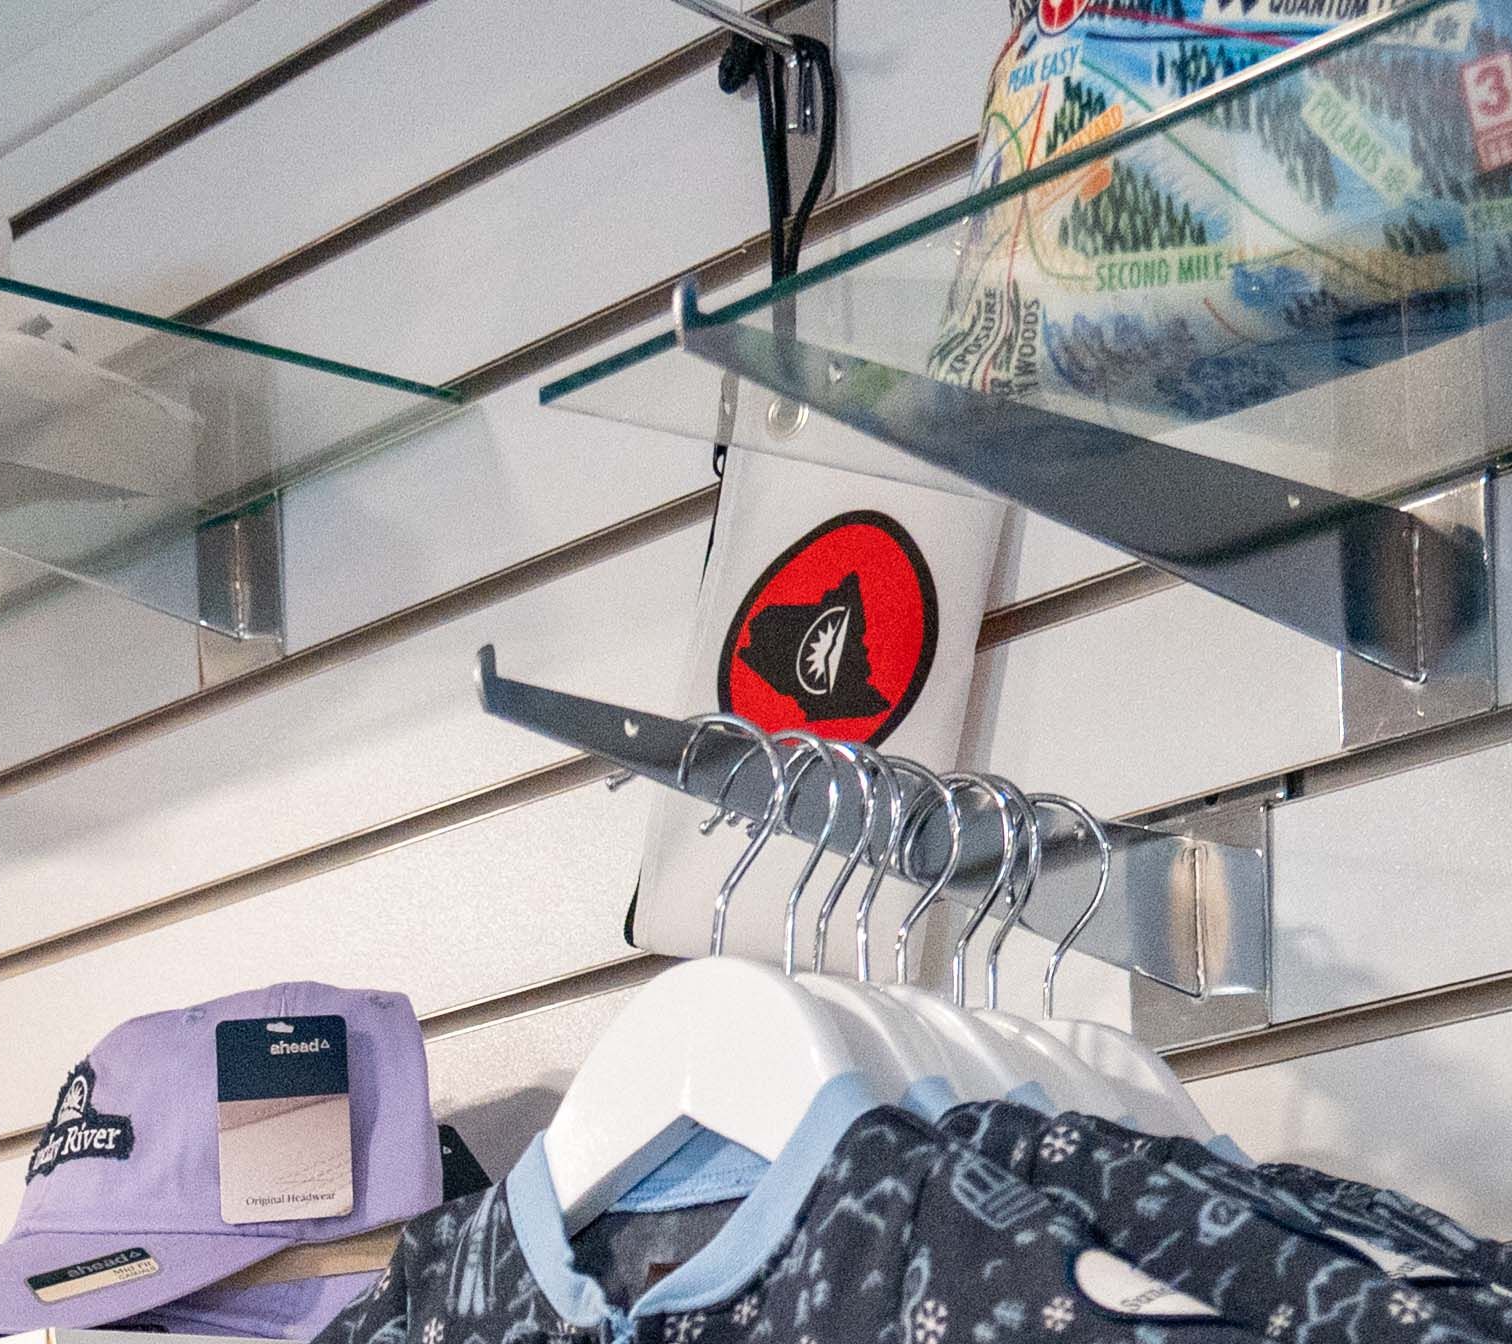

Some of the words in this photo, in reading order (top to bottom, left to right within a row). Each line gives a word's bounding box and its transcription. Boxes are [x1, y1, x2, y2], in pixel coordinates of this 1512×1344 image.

[1040, 42, 1082, 82] EASY
[1476, 65, 1510, 116] 3
[1096, 258, 1168, 292] SECOND
[1177, 251, 1222, 282] MILE
[270, 1039, 319, 1055] ahead
[61, 1122, 121, 1155] River
[246, 1194, 285, 1207] Original
[287, 1192, 336, 1203] Headwear
[67, 1253, 129, 1278] ahead
